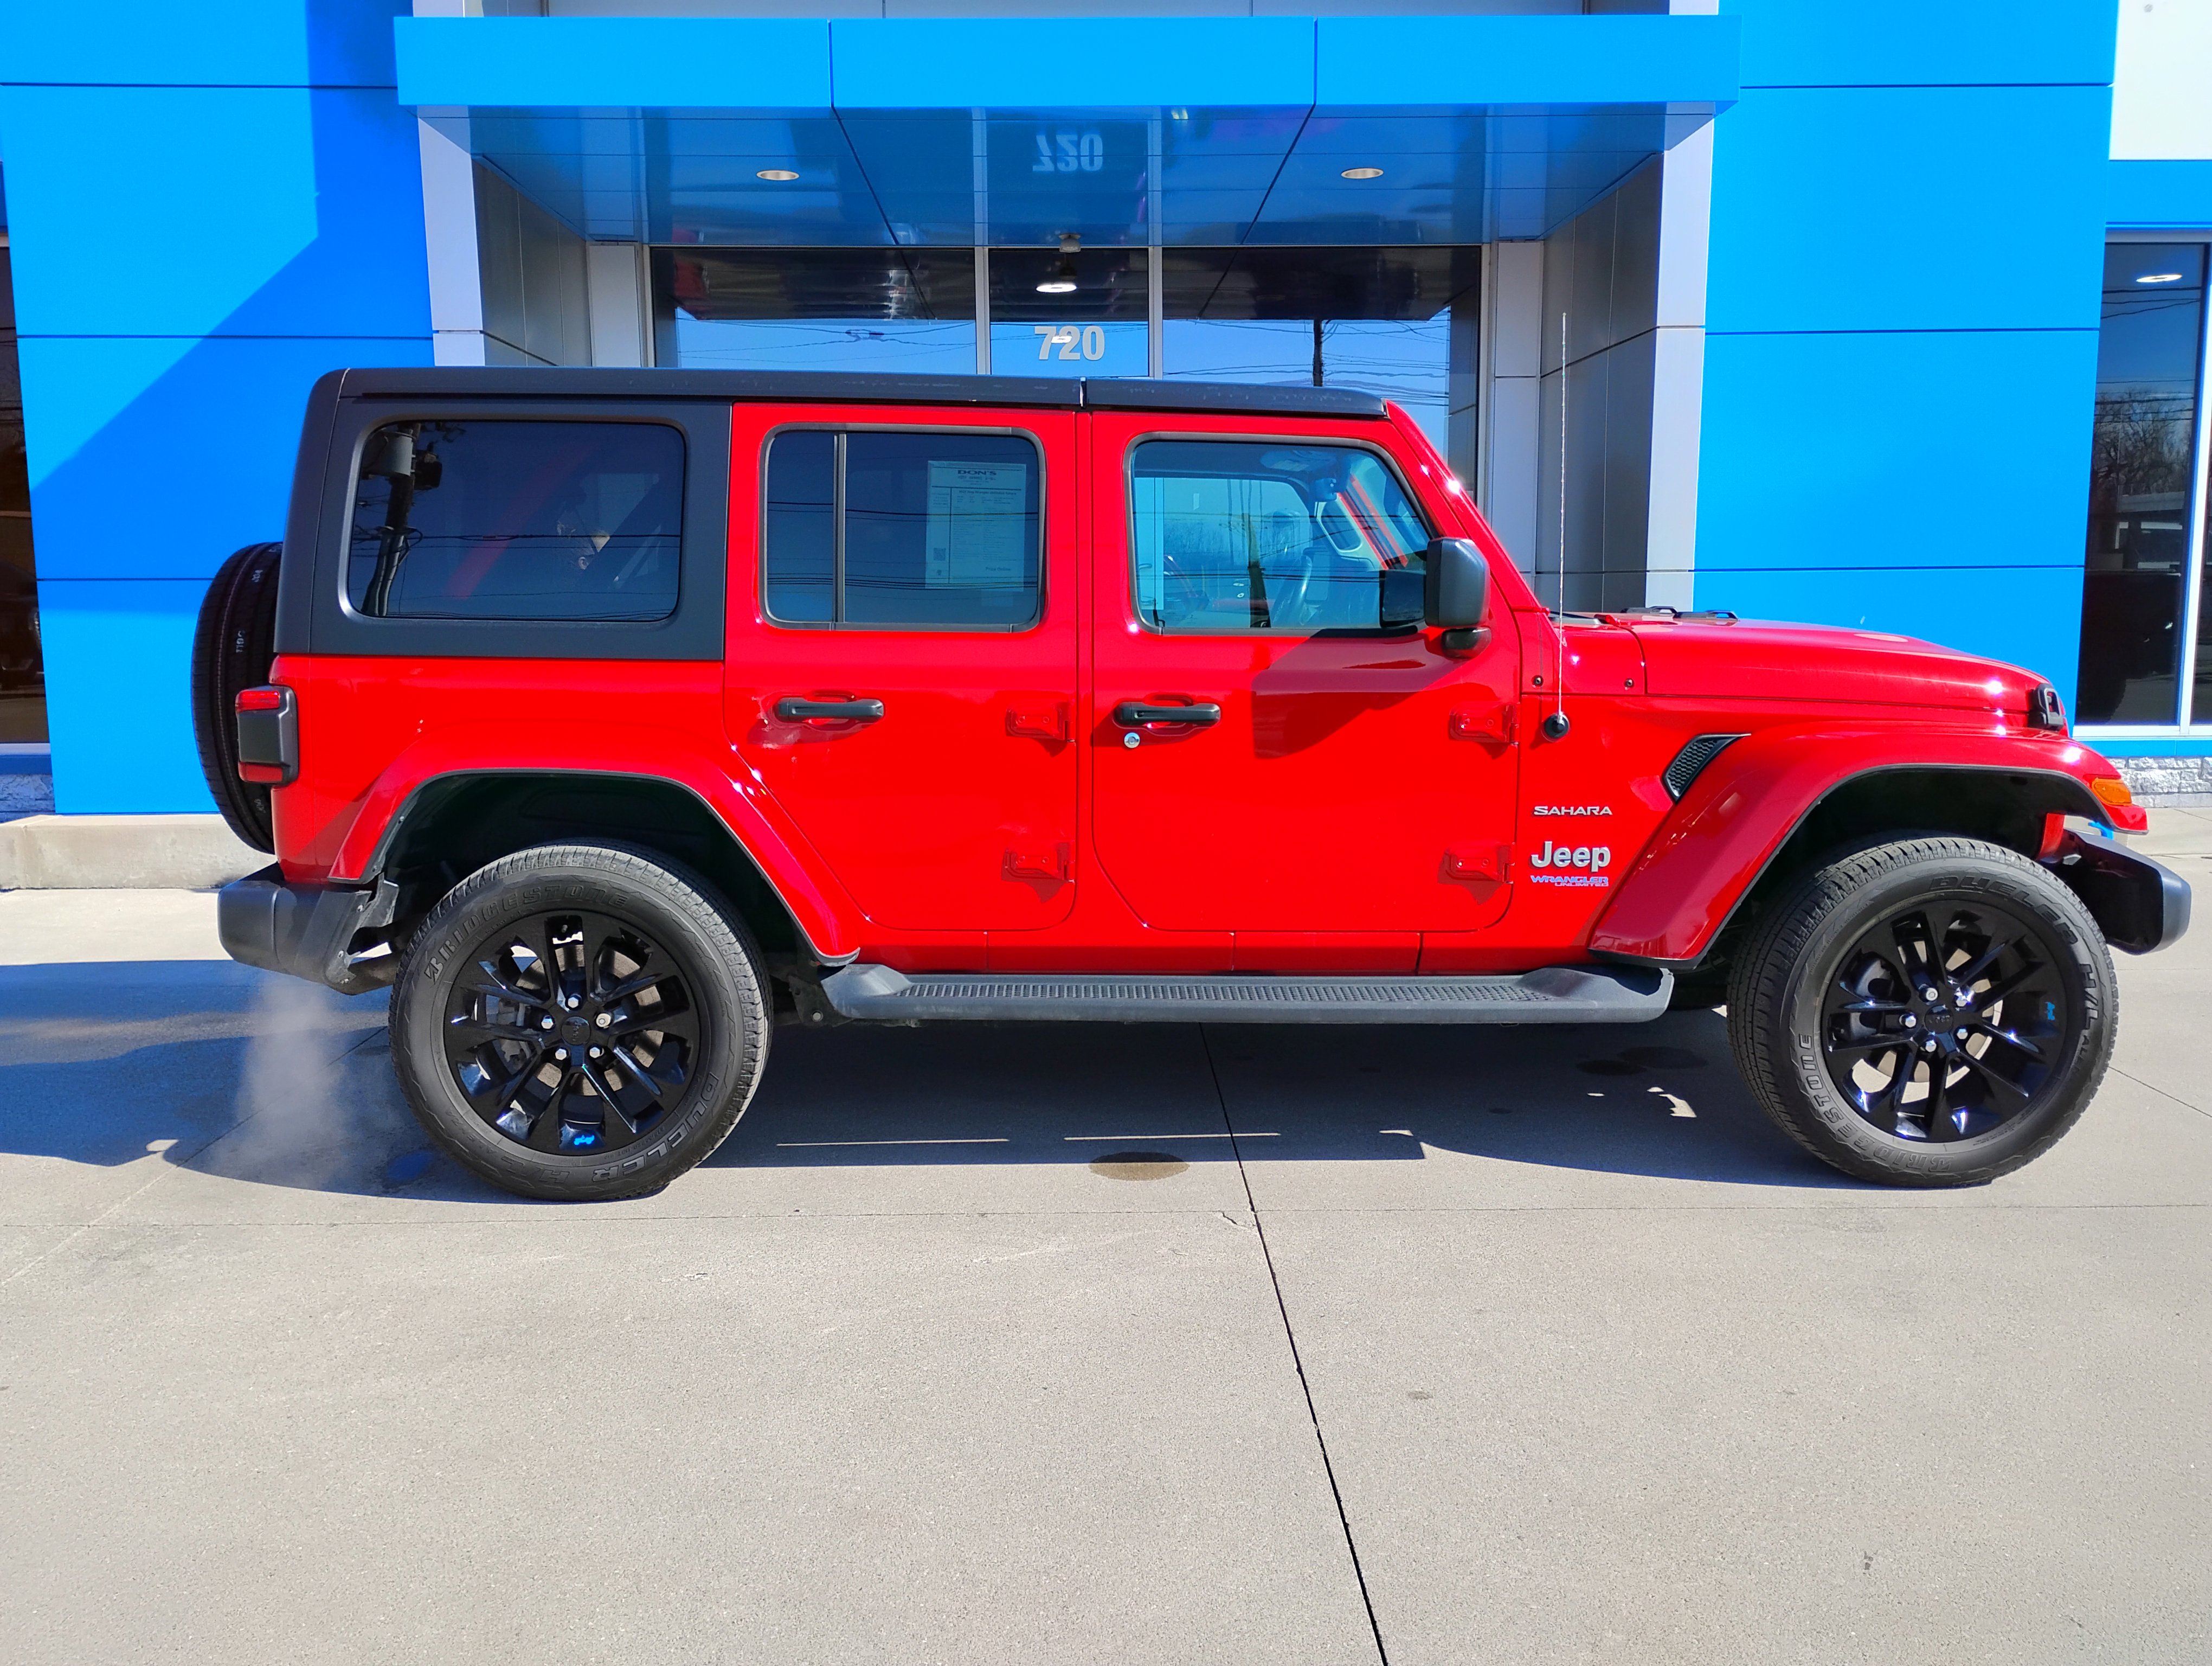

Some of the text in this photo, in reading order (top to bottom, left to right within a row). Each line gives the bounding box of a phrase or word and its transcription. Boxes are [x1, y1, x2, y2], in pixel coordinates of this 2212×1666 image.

[1034, 325, 1105, 361] 720
[1533, 806, 1612, 816] SAHARA
[1531, 841, 1611, 872] Jeep
[423, 885, 629, 984] BRIDGESTONE
[1929, 875, 2078, 945] DUELER
[591, 1071, 719, 1182] DUELER
[1798, 1033, 1954, 1172] BRIDGESTONE
